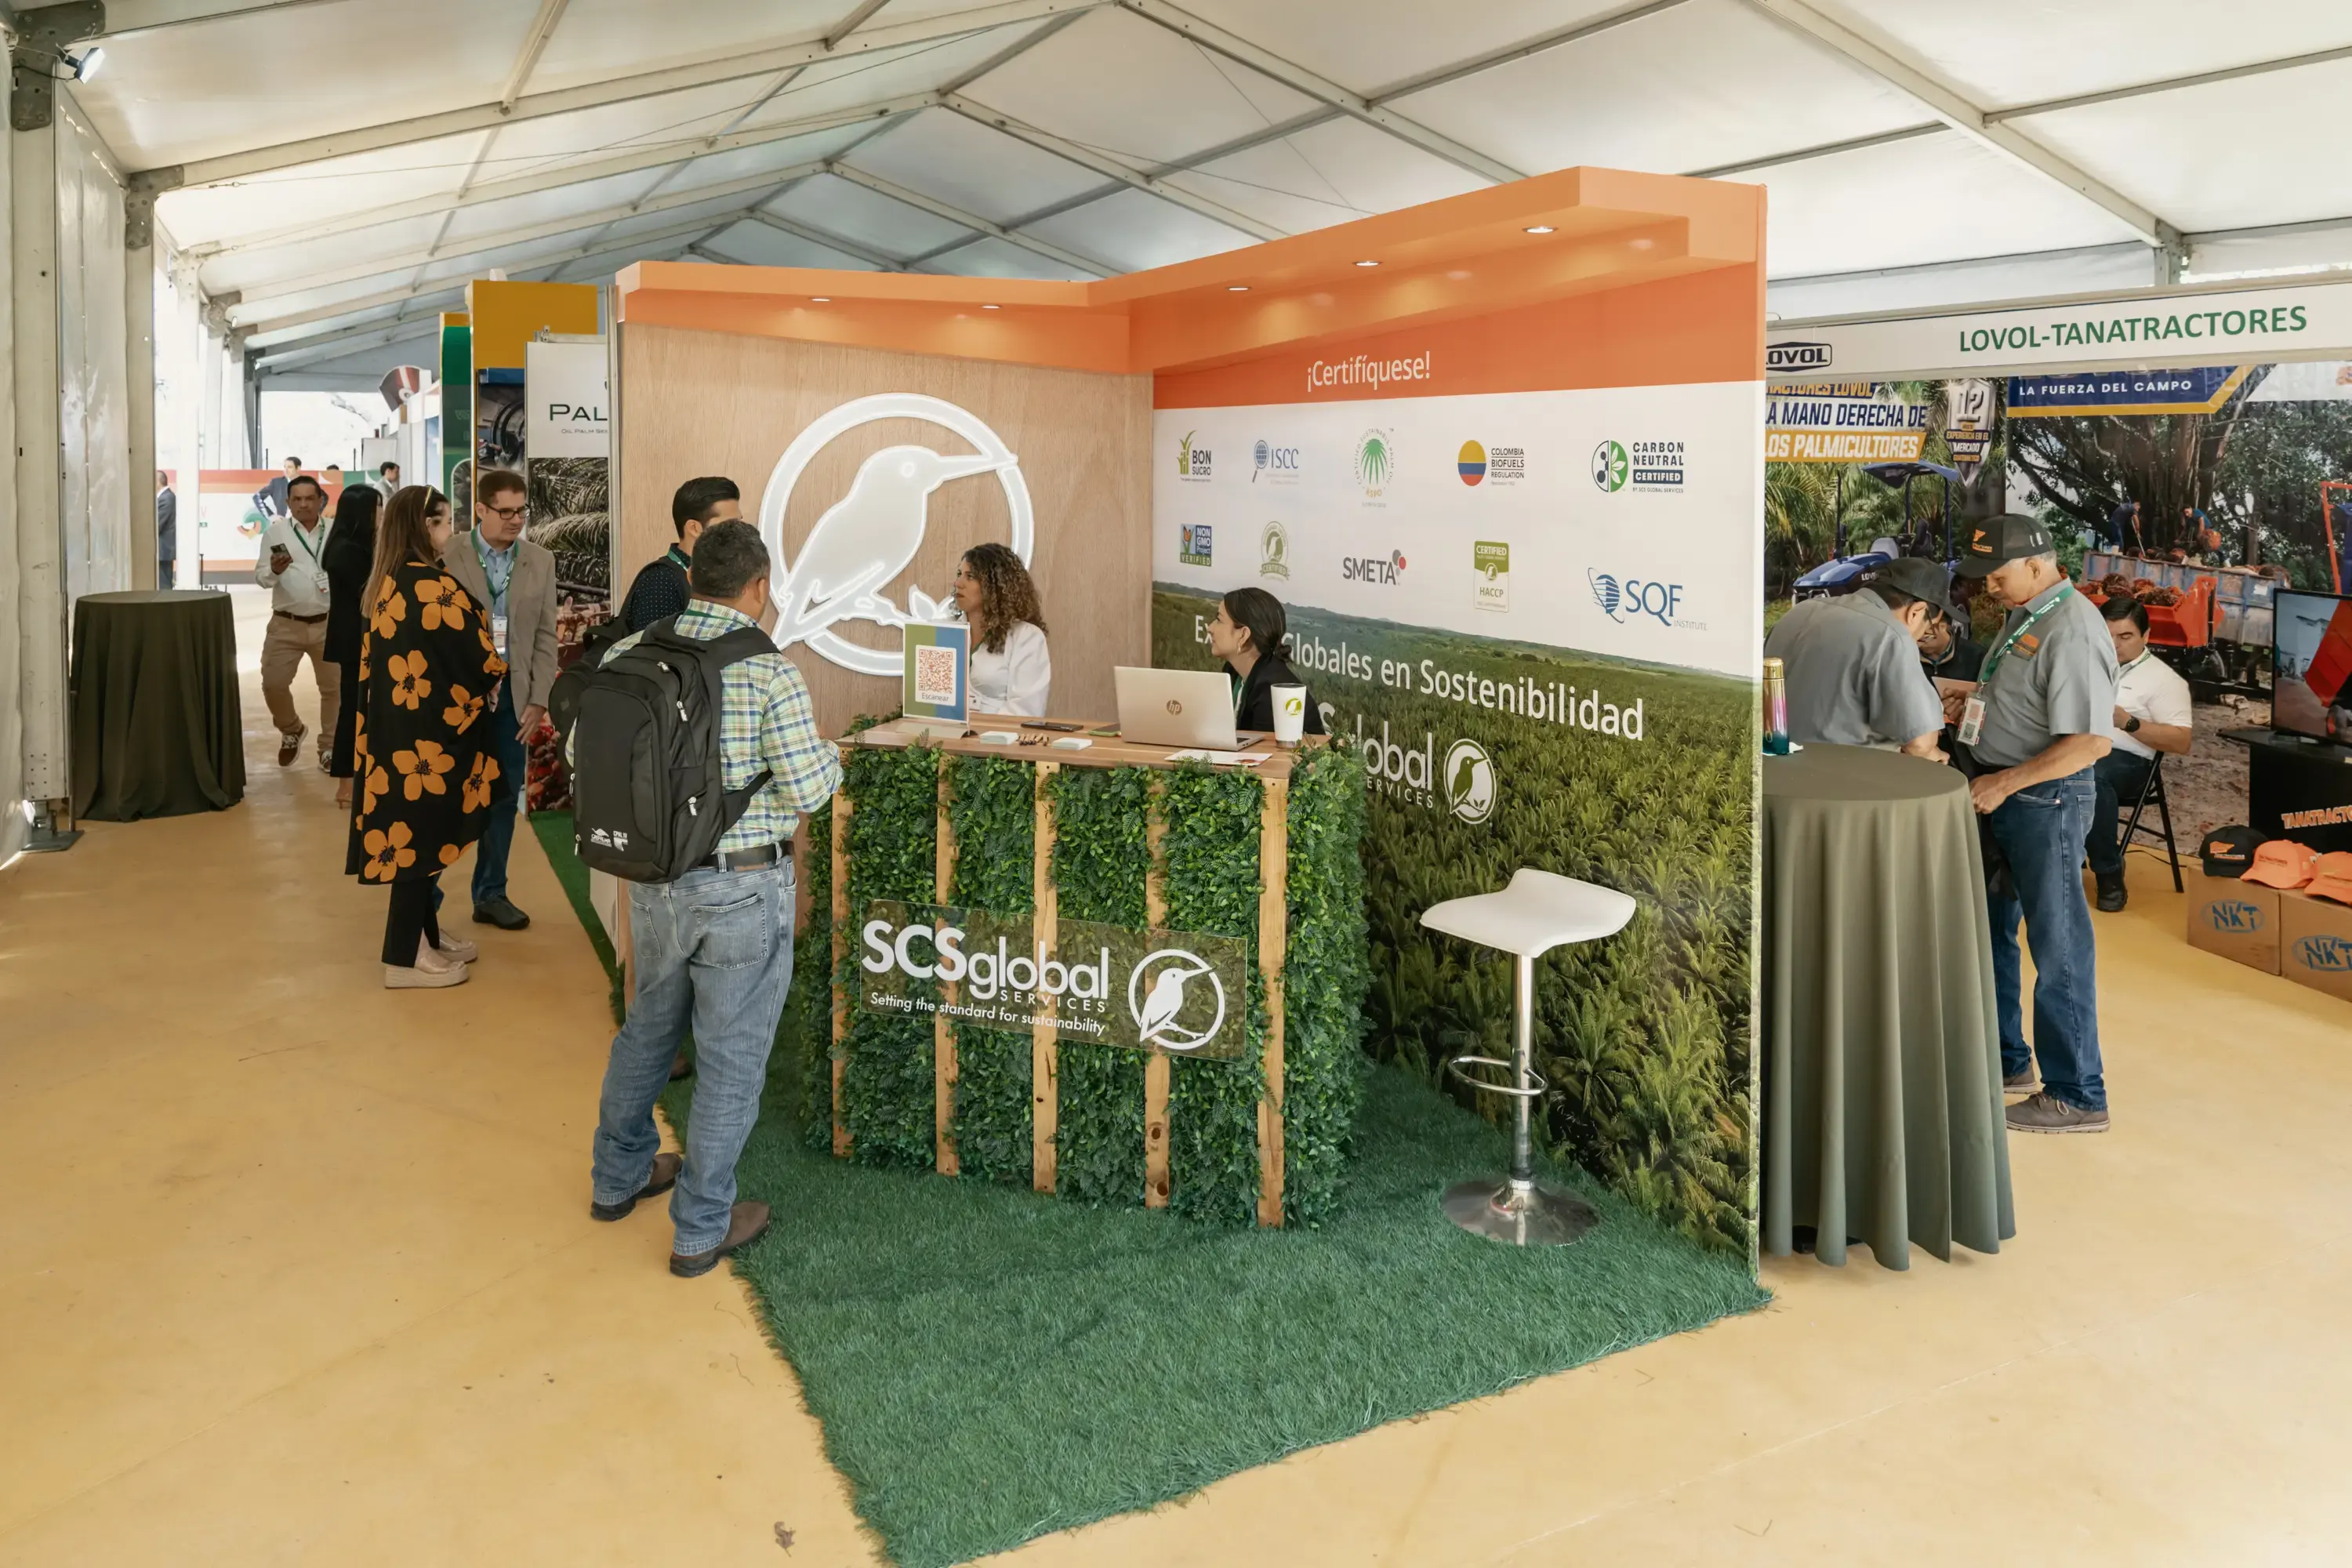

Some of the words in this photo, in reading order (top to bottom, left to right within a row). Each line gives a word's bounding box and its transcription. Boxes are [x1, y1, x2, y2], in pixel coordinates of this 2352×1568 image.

[1959, 305, 2307, 352] LOVOL-TANATRACTORES
[1766, 347, 1828, 365] OVOL
[1307, 351, 1430, 392] ¡Certifíquese!
[2020, 386, 2034, 395] LA
[2042, 383, 2095, 394] FUERZA
[2102, 383, 2128, 393] DEL
[2134, 380, 2192, 392] CAMPO
[1956, 388, 1984, 422] 12
[1766, 401, 1777, 424] A
[1781, 402, 1832, 426] MANO
[1835, 403, 1904, 427] DERECHA
[1907, 405, 1929, 427] DE
[1633, 441, 1684, 453] CARBON
[1765, 434, 1791, 457] OS
[1793, 434, 1920, 459] PALMICULTORES
[1953, 442, 1980, 452] MERCADO
[1192, 449, 1211, 465] BON
[1271, 448, 1299, 470] ISCC
[1491, 459, 1524, 468] BIOFUELS
[1633, 455, 1684, 466] NEUTRAL
[1192, 466, 1211, 476] SUCRO
[1635, 471, 1682, 481] CERTIFIED
[1196, 527, 1211, 537] NON
[1196, 537, 1211, 546] GMO
[1476, 545, 1508, 556] CERTIFIED
[1181, 554, 1210, 565] VERIFIED
[1342, 557, 1396, 586] SMETA
[1479, 586, 1504, 597] HACCP
[1625, 579, 1683, 626] SQF
[1673, 619, 1708, 630] INSTITUTE
[921, 692, 949, 702] Escanear
[1381, 659, 1410, 690] en
[1420, 659, 1643, 742] Sostenibilidad
[1168, 699, 1181, 716] hp
[1367, 776, 1433, 808] ERVICES
[2212, 902, 2258, 931] NKT
[862, 920, 1109, 1000] SCSglobal
[2304, 937, 2352, 971] NKT
[1000, 989, 1106, 1013] SERVICES
[870, 991, 912, 1013] Setting
[916, 996, 935, 1011] the
[939, 1002, 995, 1019] standard
[999, 1007, 1018, 1023] for
[1022, 1012, 1105, 1036] sustainability
